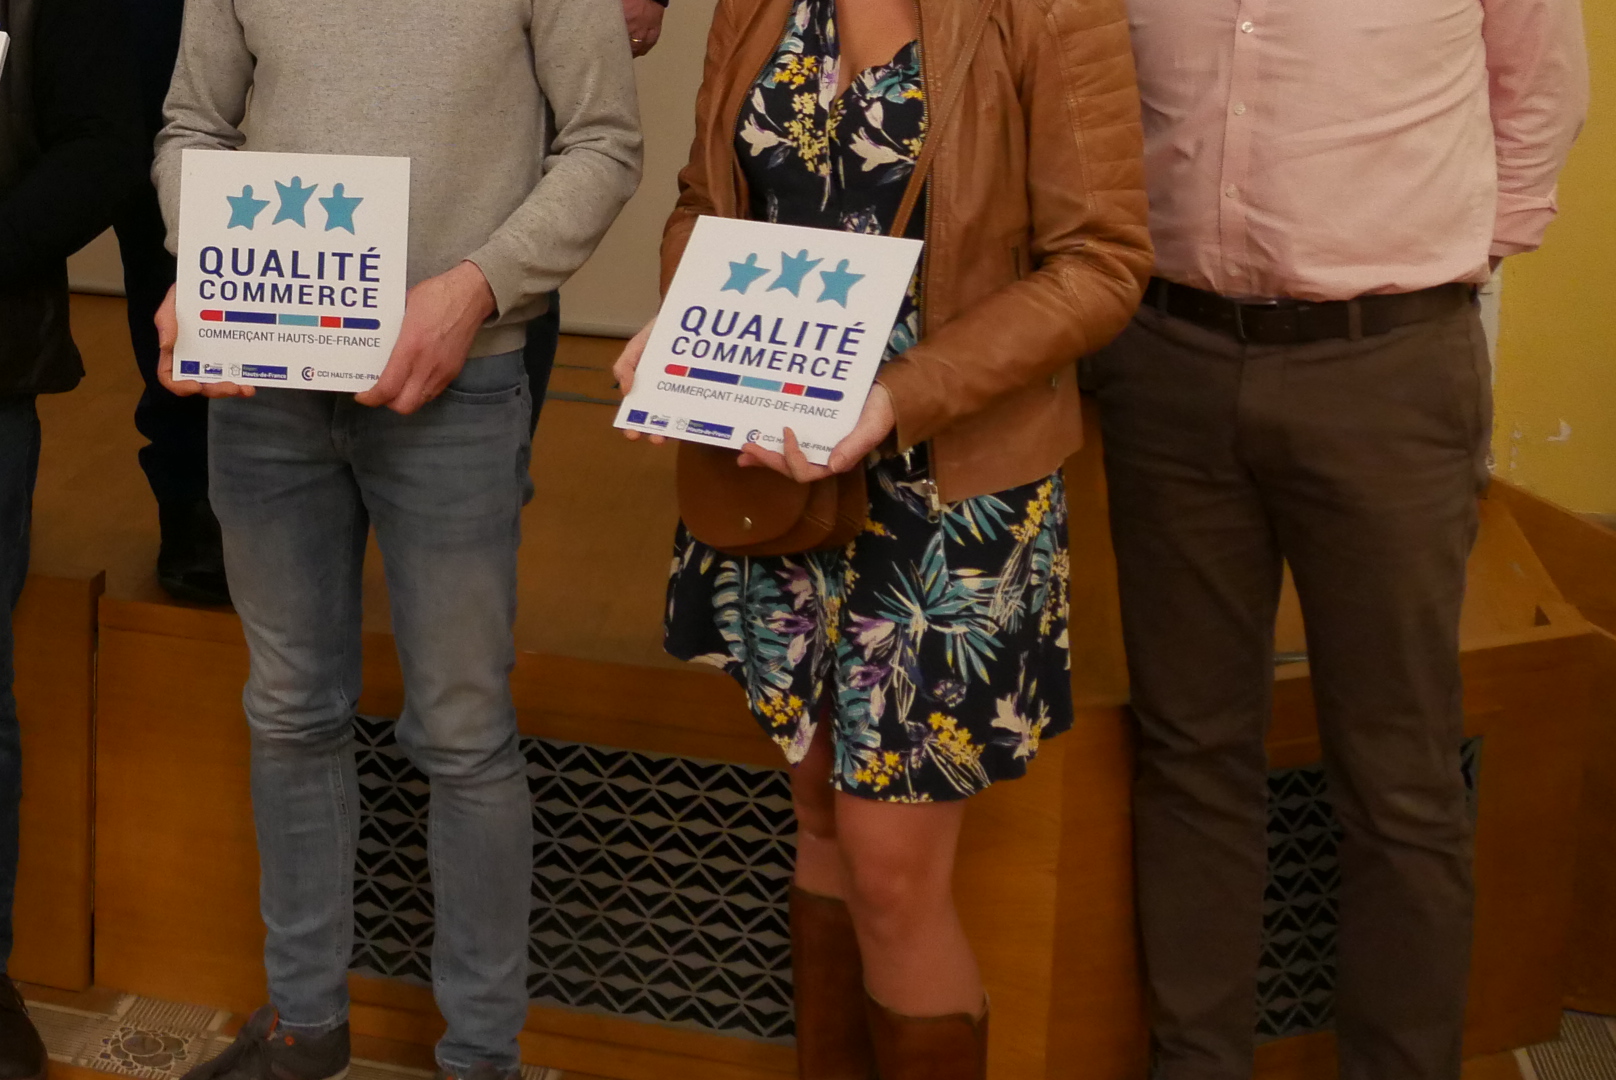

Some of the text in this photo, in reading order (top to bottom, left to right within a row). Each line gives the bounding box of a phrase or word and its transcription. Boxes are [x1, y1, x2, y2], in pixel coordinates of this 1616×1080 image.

[199, 246, 381, 283] QUALITÉ
[199, 279, 379, 308] COMMERCE
[198, 328, 381, 348] COMMERÇANT HAUTS-DE-FRANCE
[680, 305, 866, 357] QUALITÉ
[317, 370, 380, 380] CCI HAUTS-DE-FRA
[671, 336, 852, 381] COMMERCE
[657, 380, 839, 420] COMMERÇANT HAUTS-DE-FRANCE
